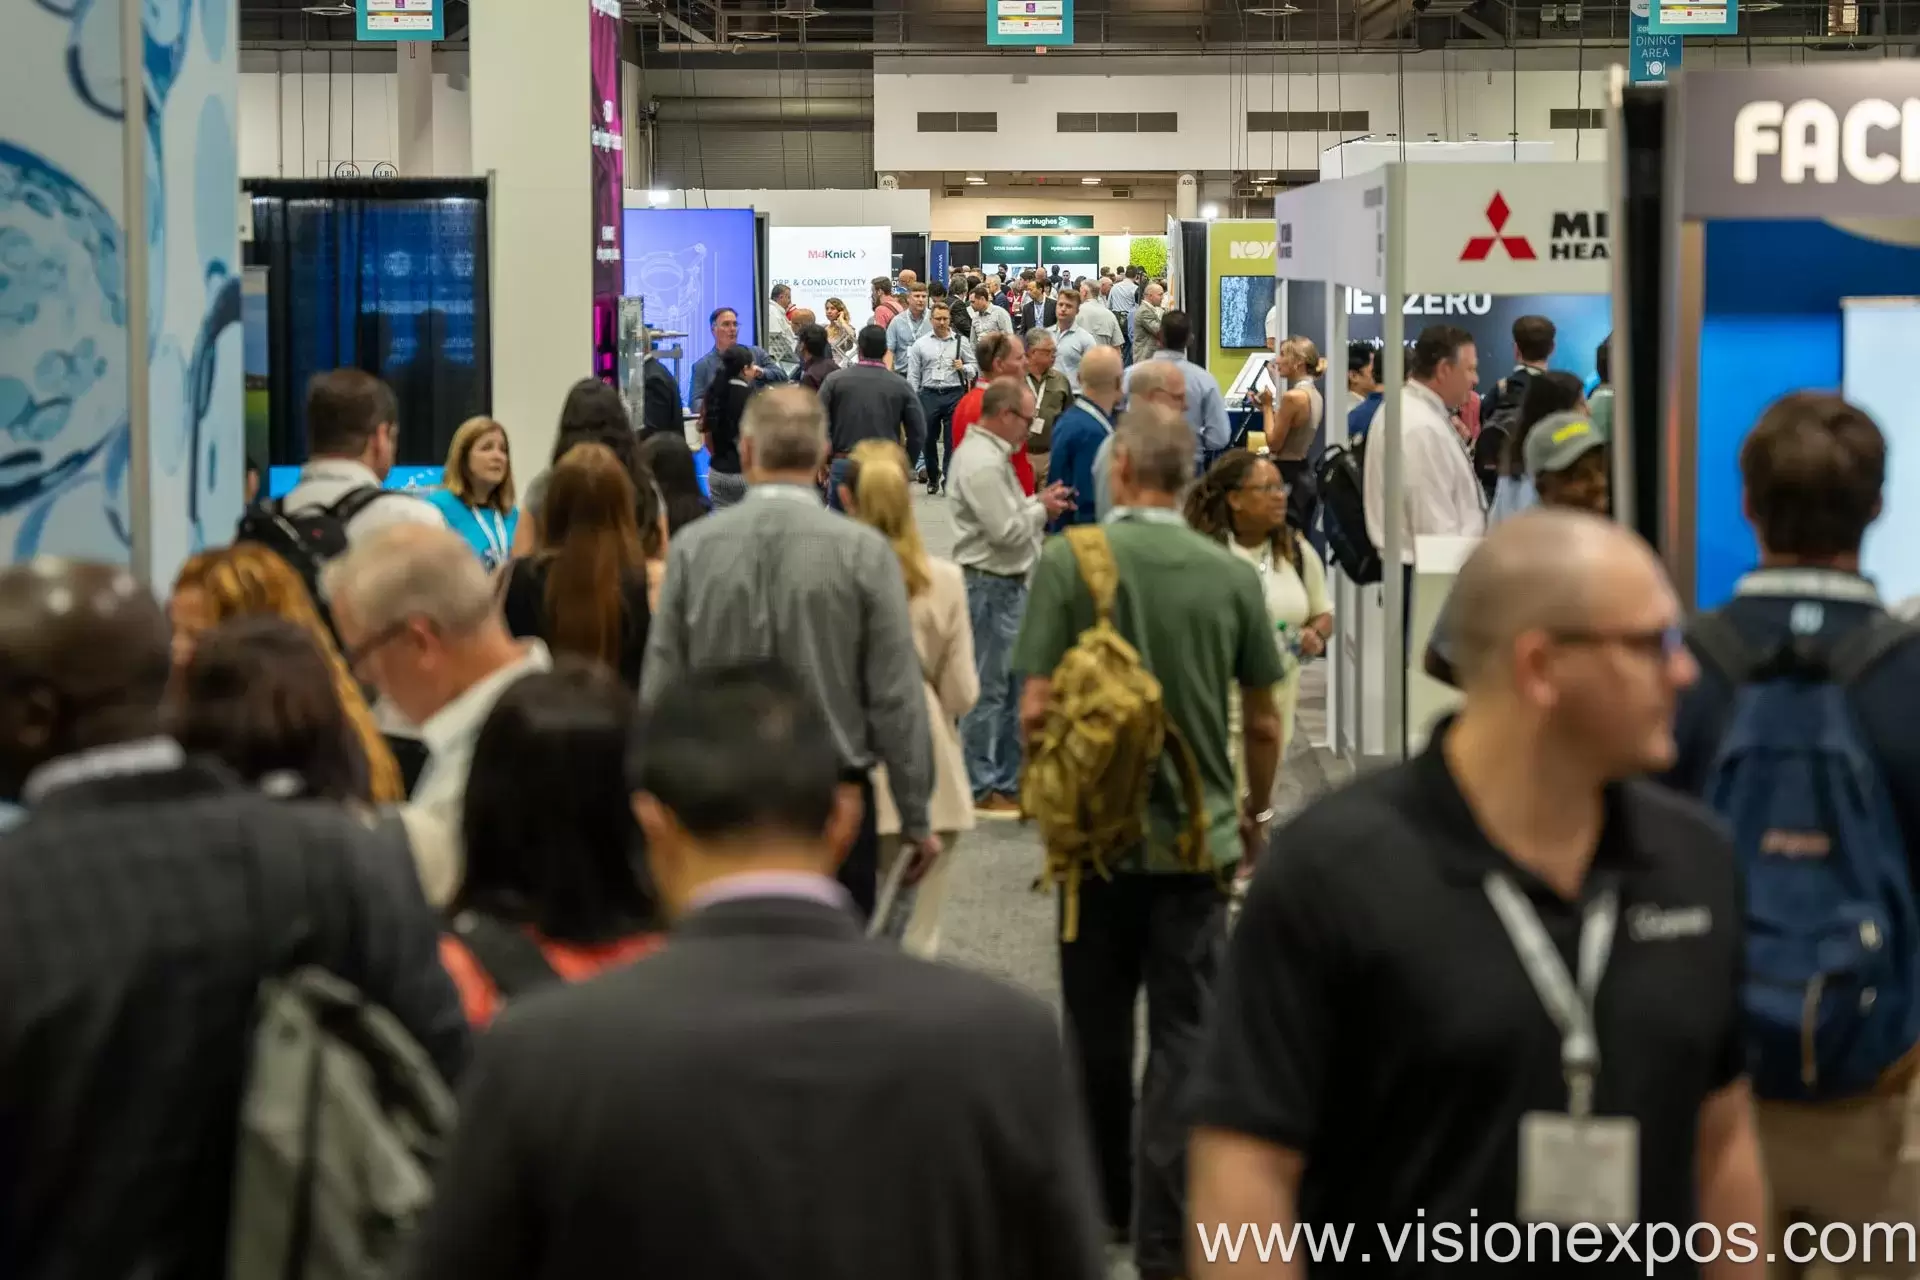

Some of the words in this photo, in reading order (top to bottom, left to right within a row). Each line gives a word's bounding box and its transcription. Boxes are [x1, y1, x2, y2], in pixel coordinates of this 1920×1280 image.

[1636, 35, 1676, 46] DINING
[1641, 47, 1670, 58] AREA
[380, 170, 393, 178] LBI
[1011, 217, 1031, 225] Baker
[1032, 217, 1057, 226] Hughes
[802, 278, 866, 286] CONDUCTIVITY
[1402, 293, 1492, 315] ZERO
